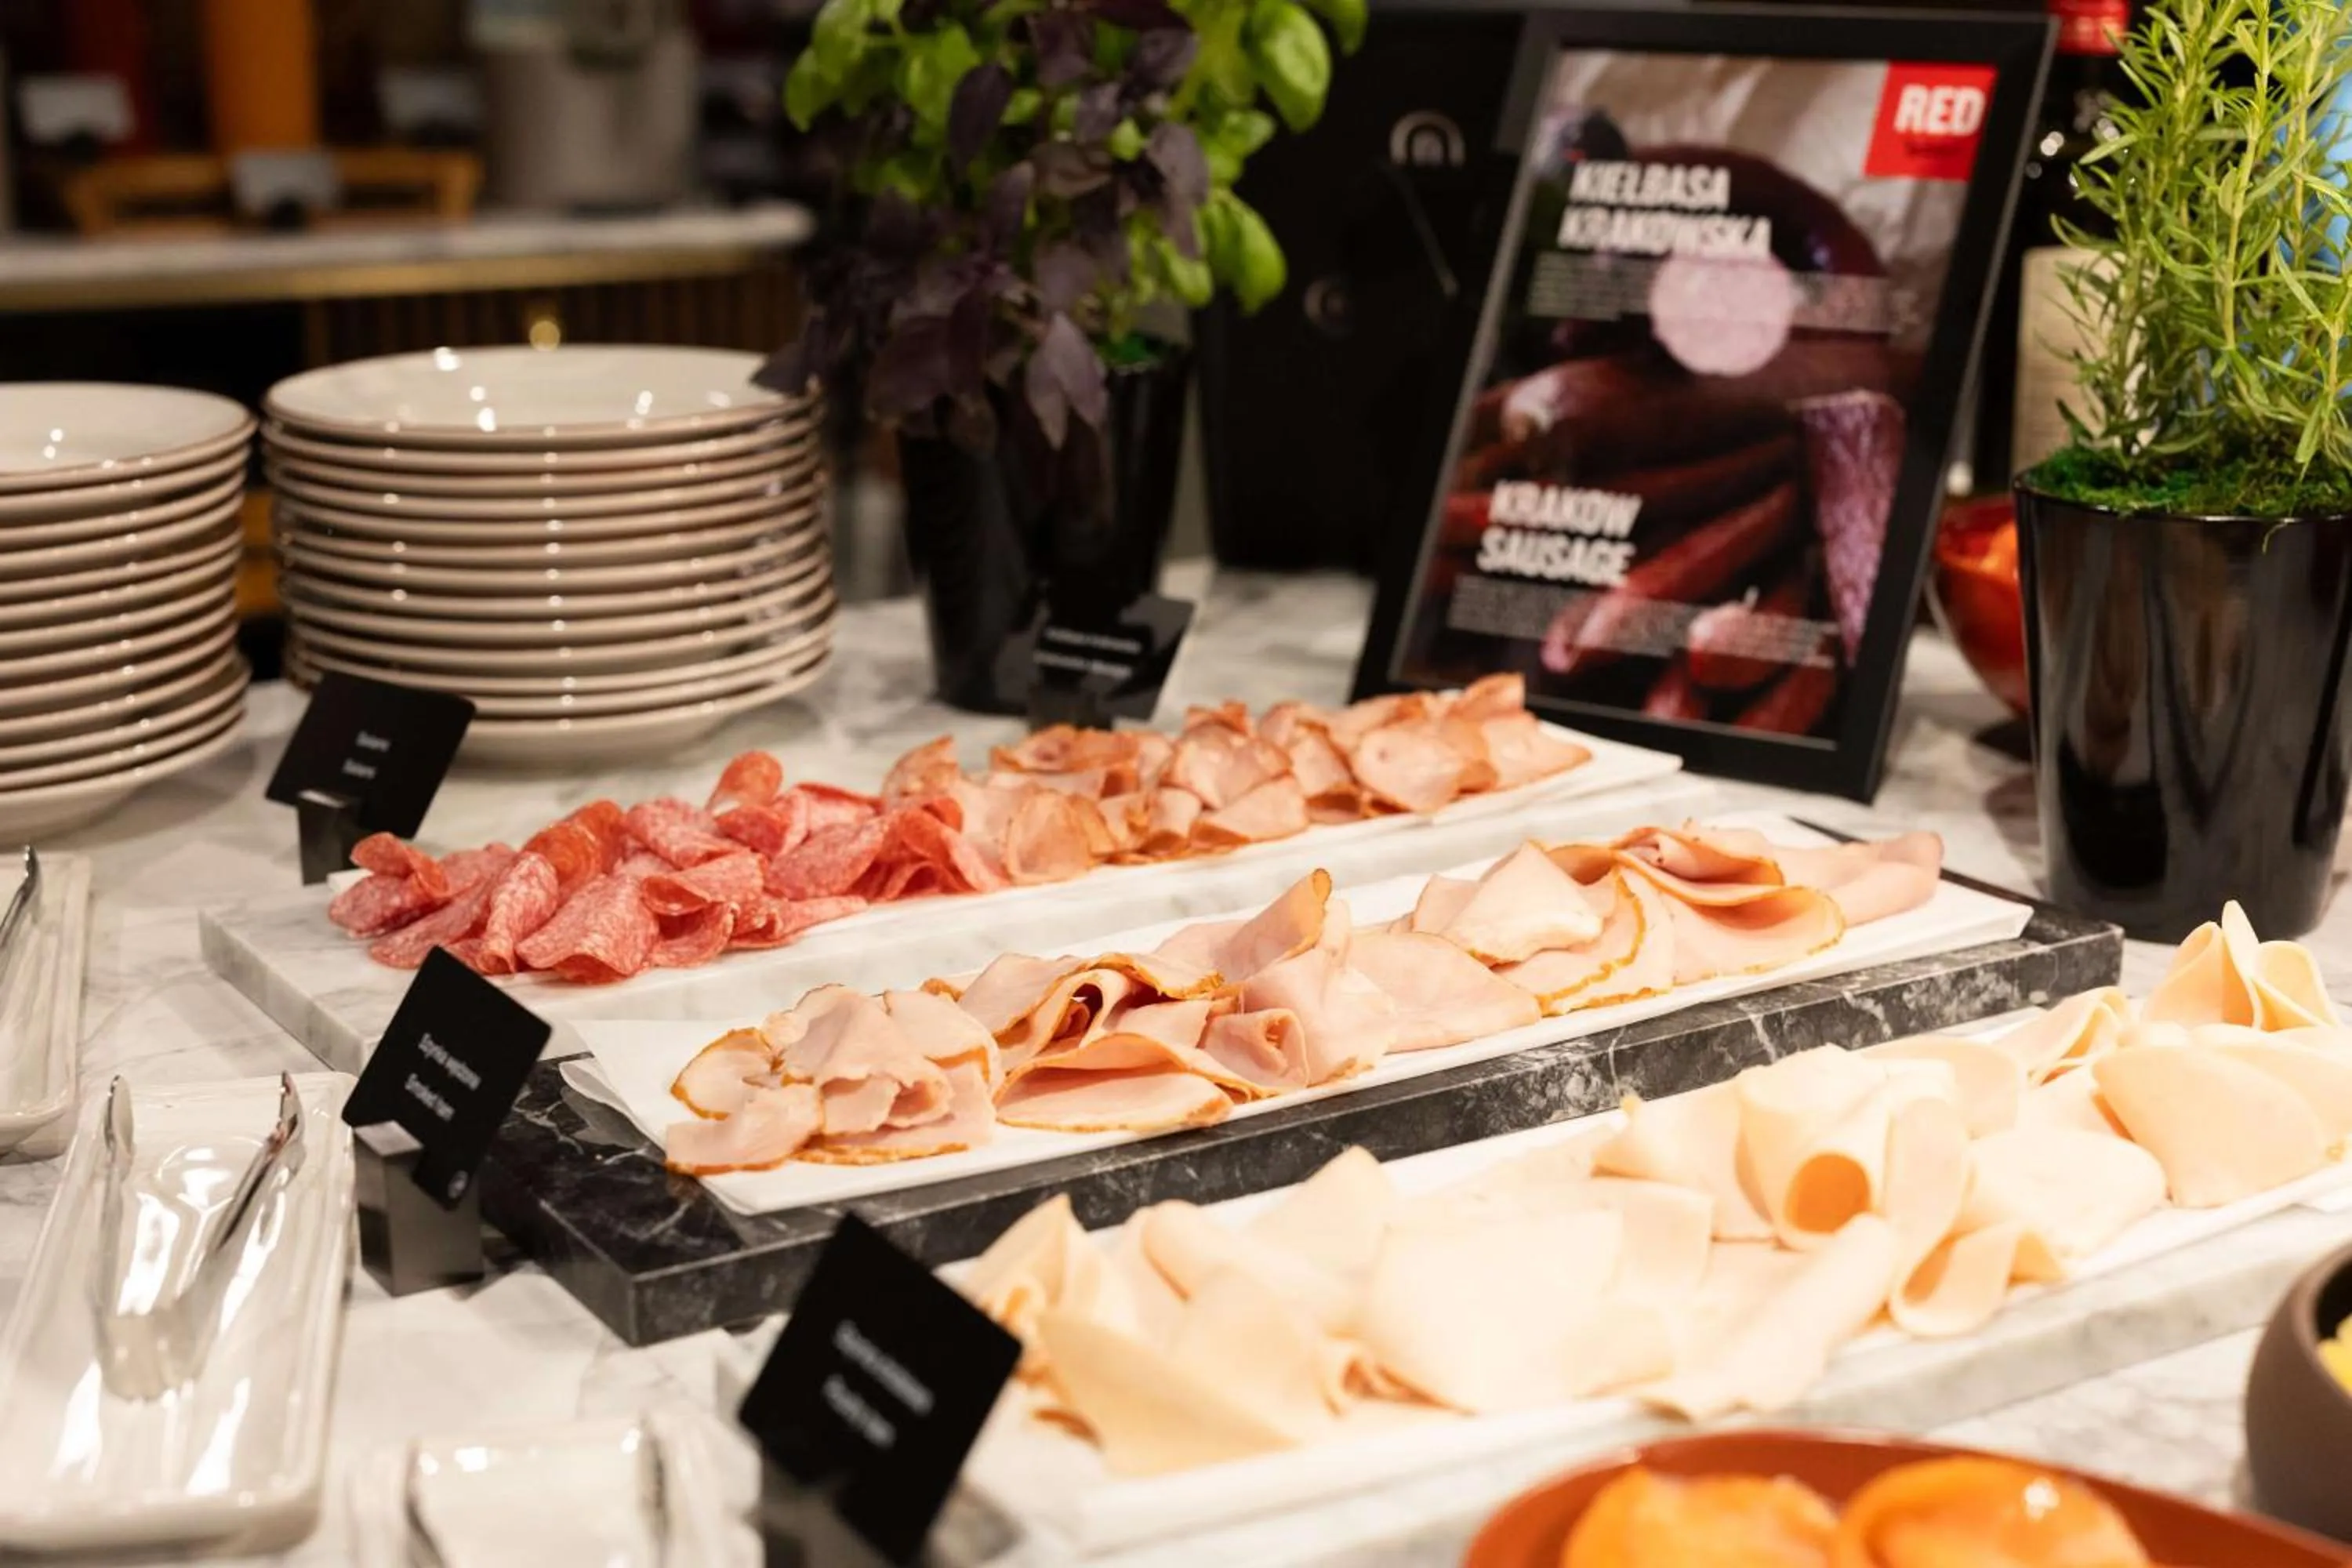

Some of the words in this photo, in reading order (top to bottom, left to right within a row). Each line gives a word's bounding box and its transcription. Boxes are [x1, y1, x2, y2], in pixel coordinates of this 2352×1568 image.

[1893, 83, 1987, 136] RED
[1558, 205, 1773, 258] KRAKOWSKA
[1488, 479, 1642, 539] KRAKOW
[1475, 524, 1638, 591] SAUSAGE
